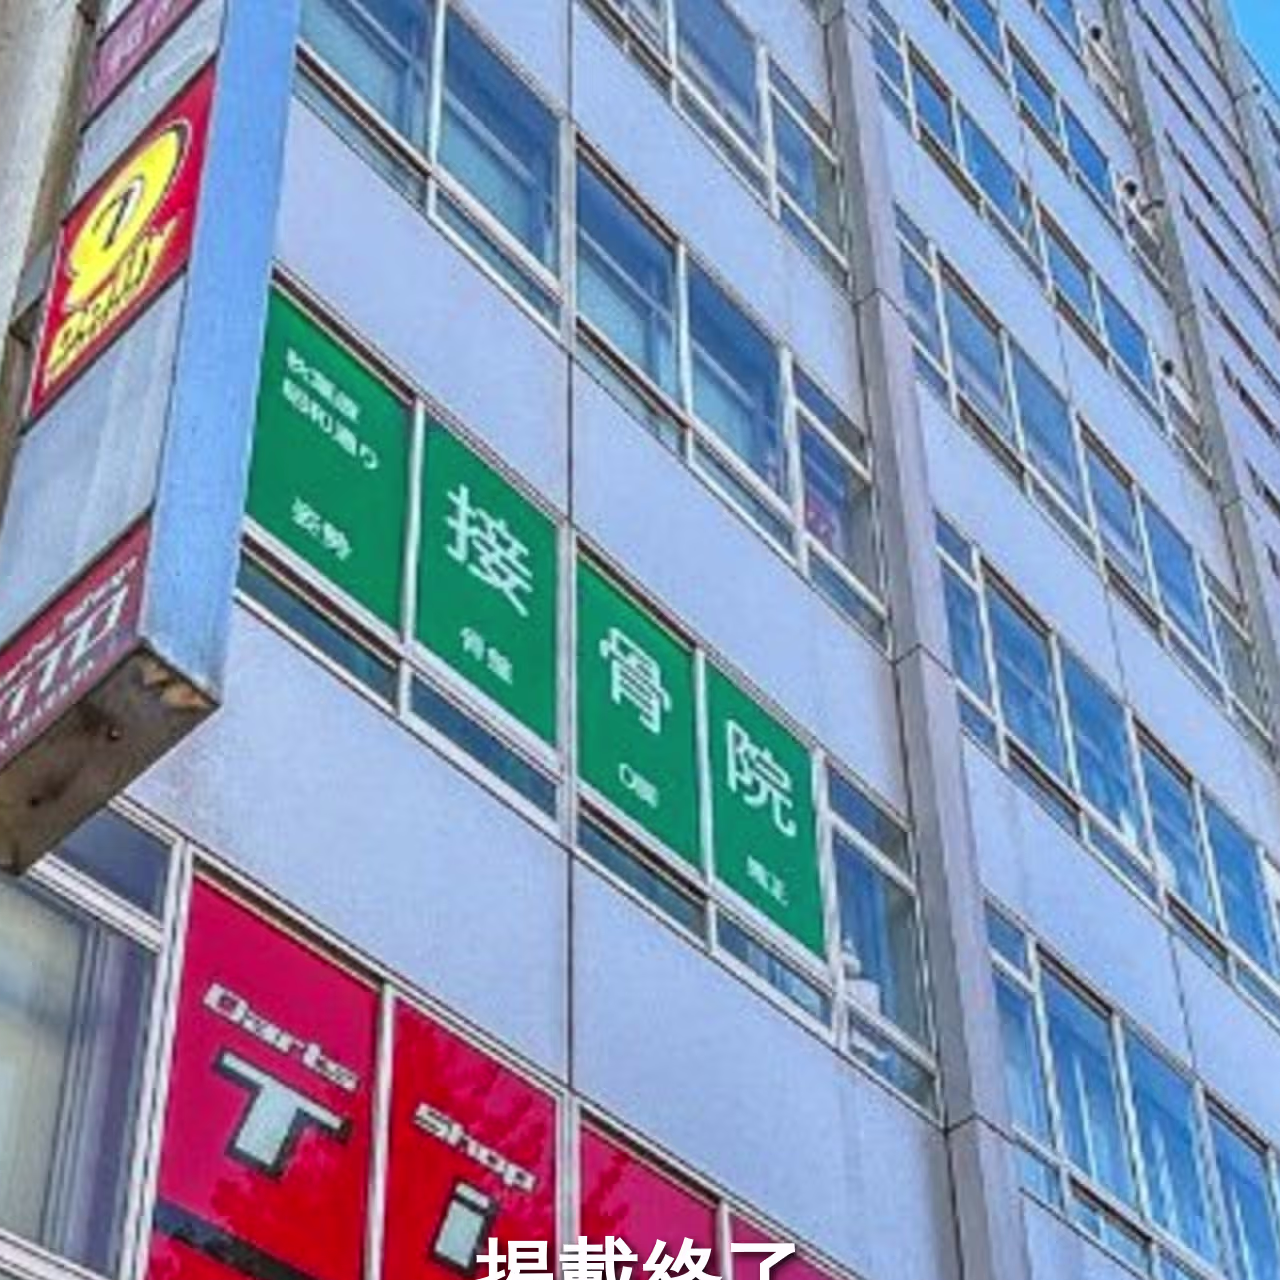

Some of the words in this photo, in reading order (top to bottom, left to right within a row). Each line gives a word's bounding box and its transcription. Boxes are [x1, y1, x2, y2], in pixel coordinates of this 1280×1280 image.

[446, 484, 796, 837] 接骨院
[204, 982, 360, 1091] Darts
